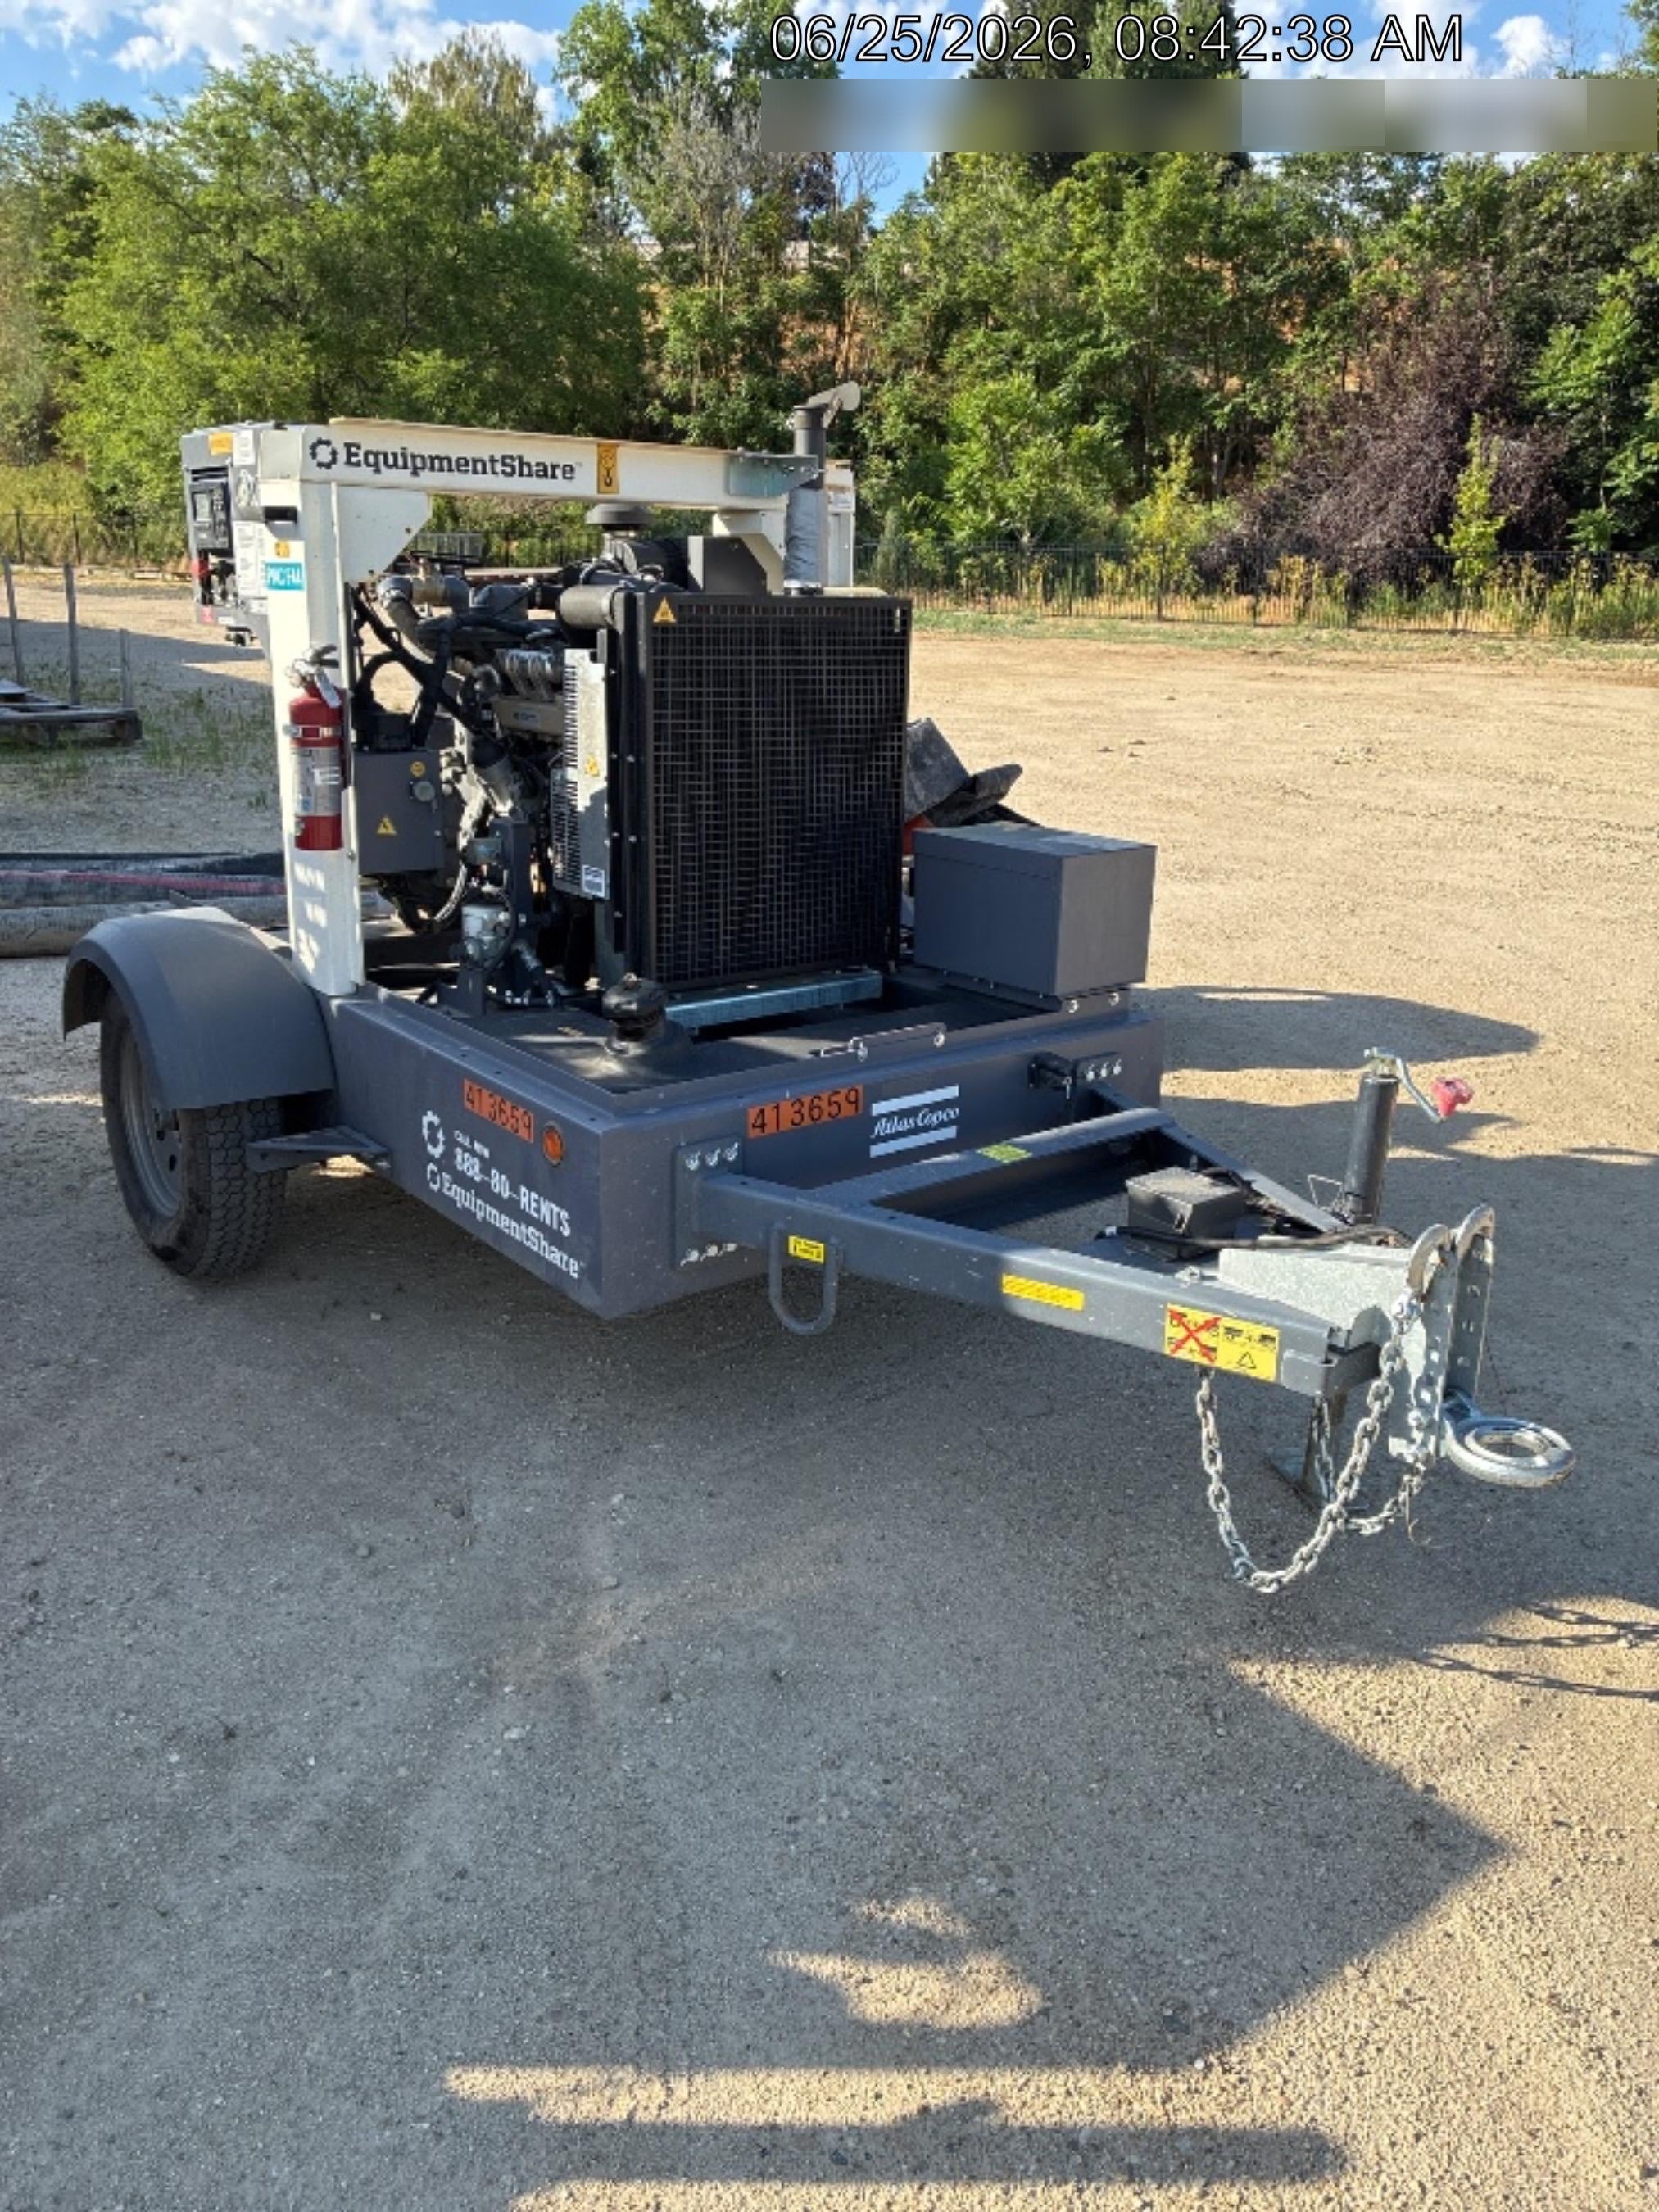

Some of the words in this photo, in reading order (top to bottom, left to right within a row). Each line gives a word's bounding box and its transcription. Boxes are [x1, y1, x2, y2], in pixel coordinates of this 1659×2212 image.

[343, 442, 576, 480] EquipmentShare
[465, 1083, 532, 1139] 413659
[750, 1087, 860, 1135] 413659
[870, 1116, 916, 1139] Atlas
[916, 1108, 959, 1128] Copco
[441, 1171, 579, 1279] EquipmentShare
